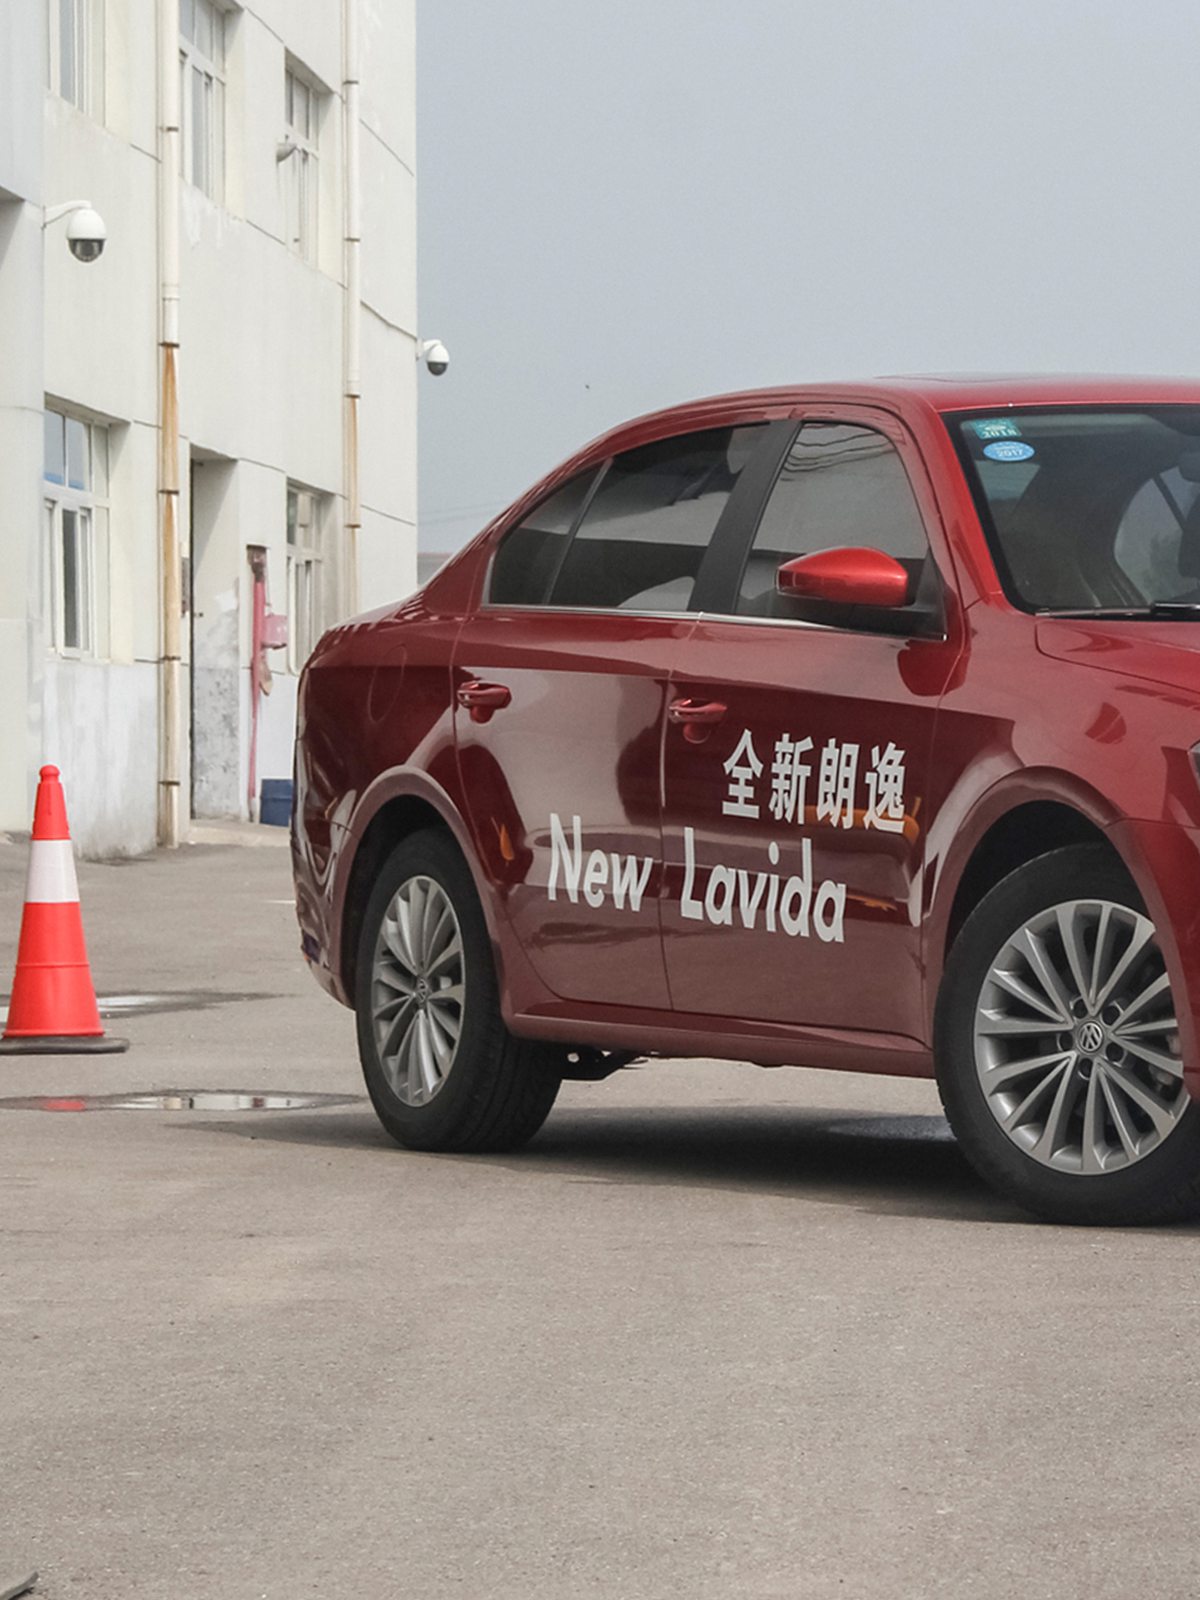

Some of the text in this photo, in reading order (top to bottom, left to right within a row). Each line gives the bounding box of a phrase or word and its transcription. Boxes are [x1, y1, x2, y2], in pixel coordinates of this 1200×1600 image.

[722, 728, 907, 835] 全新朗逸
[547, 813, 848, 943] New Lavida
